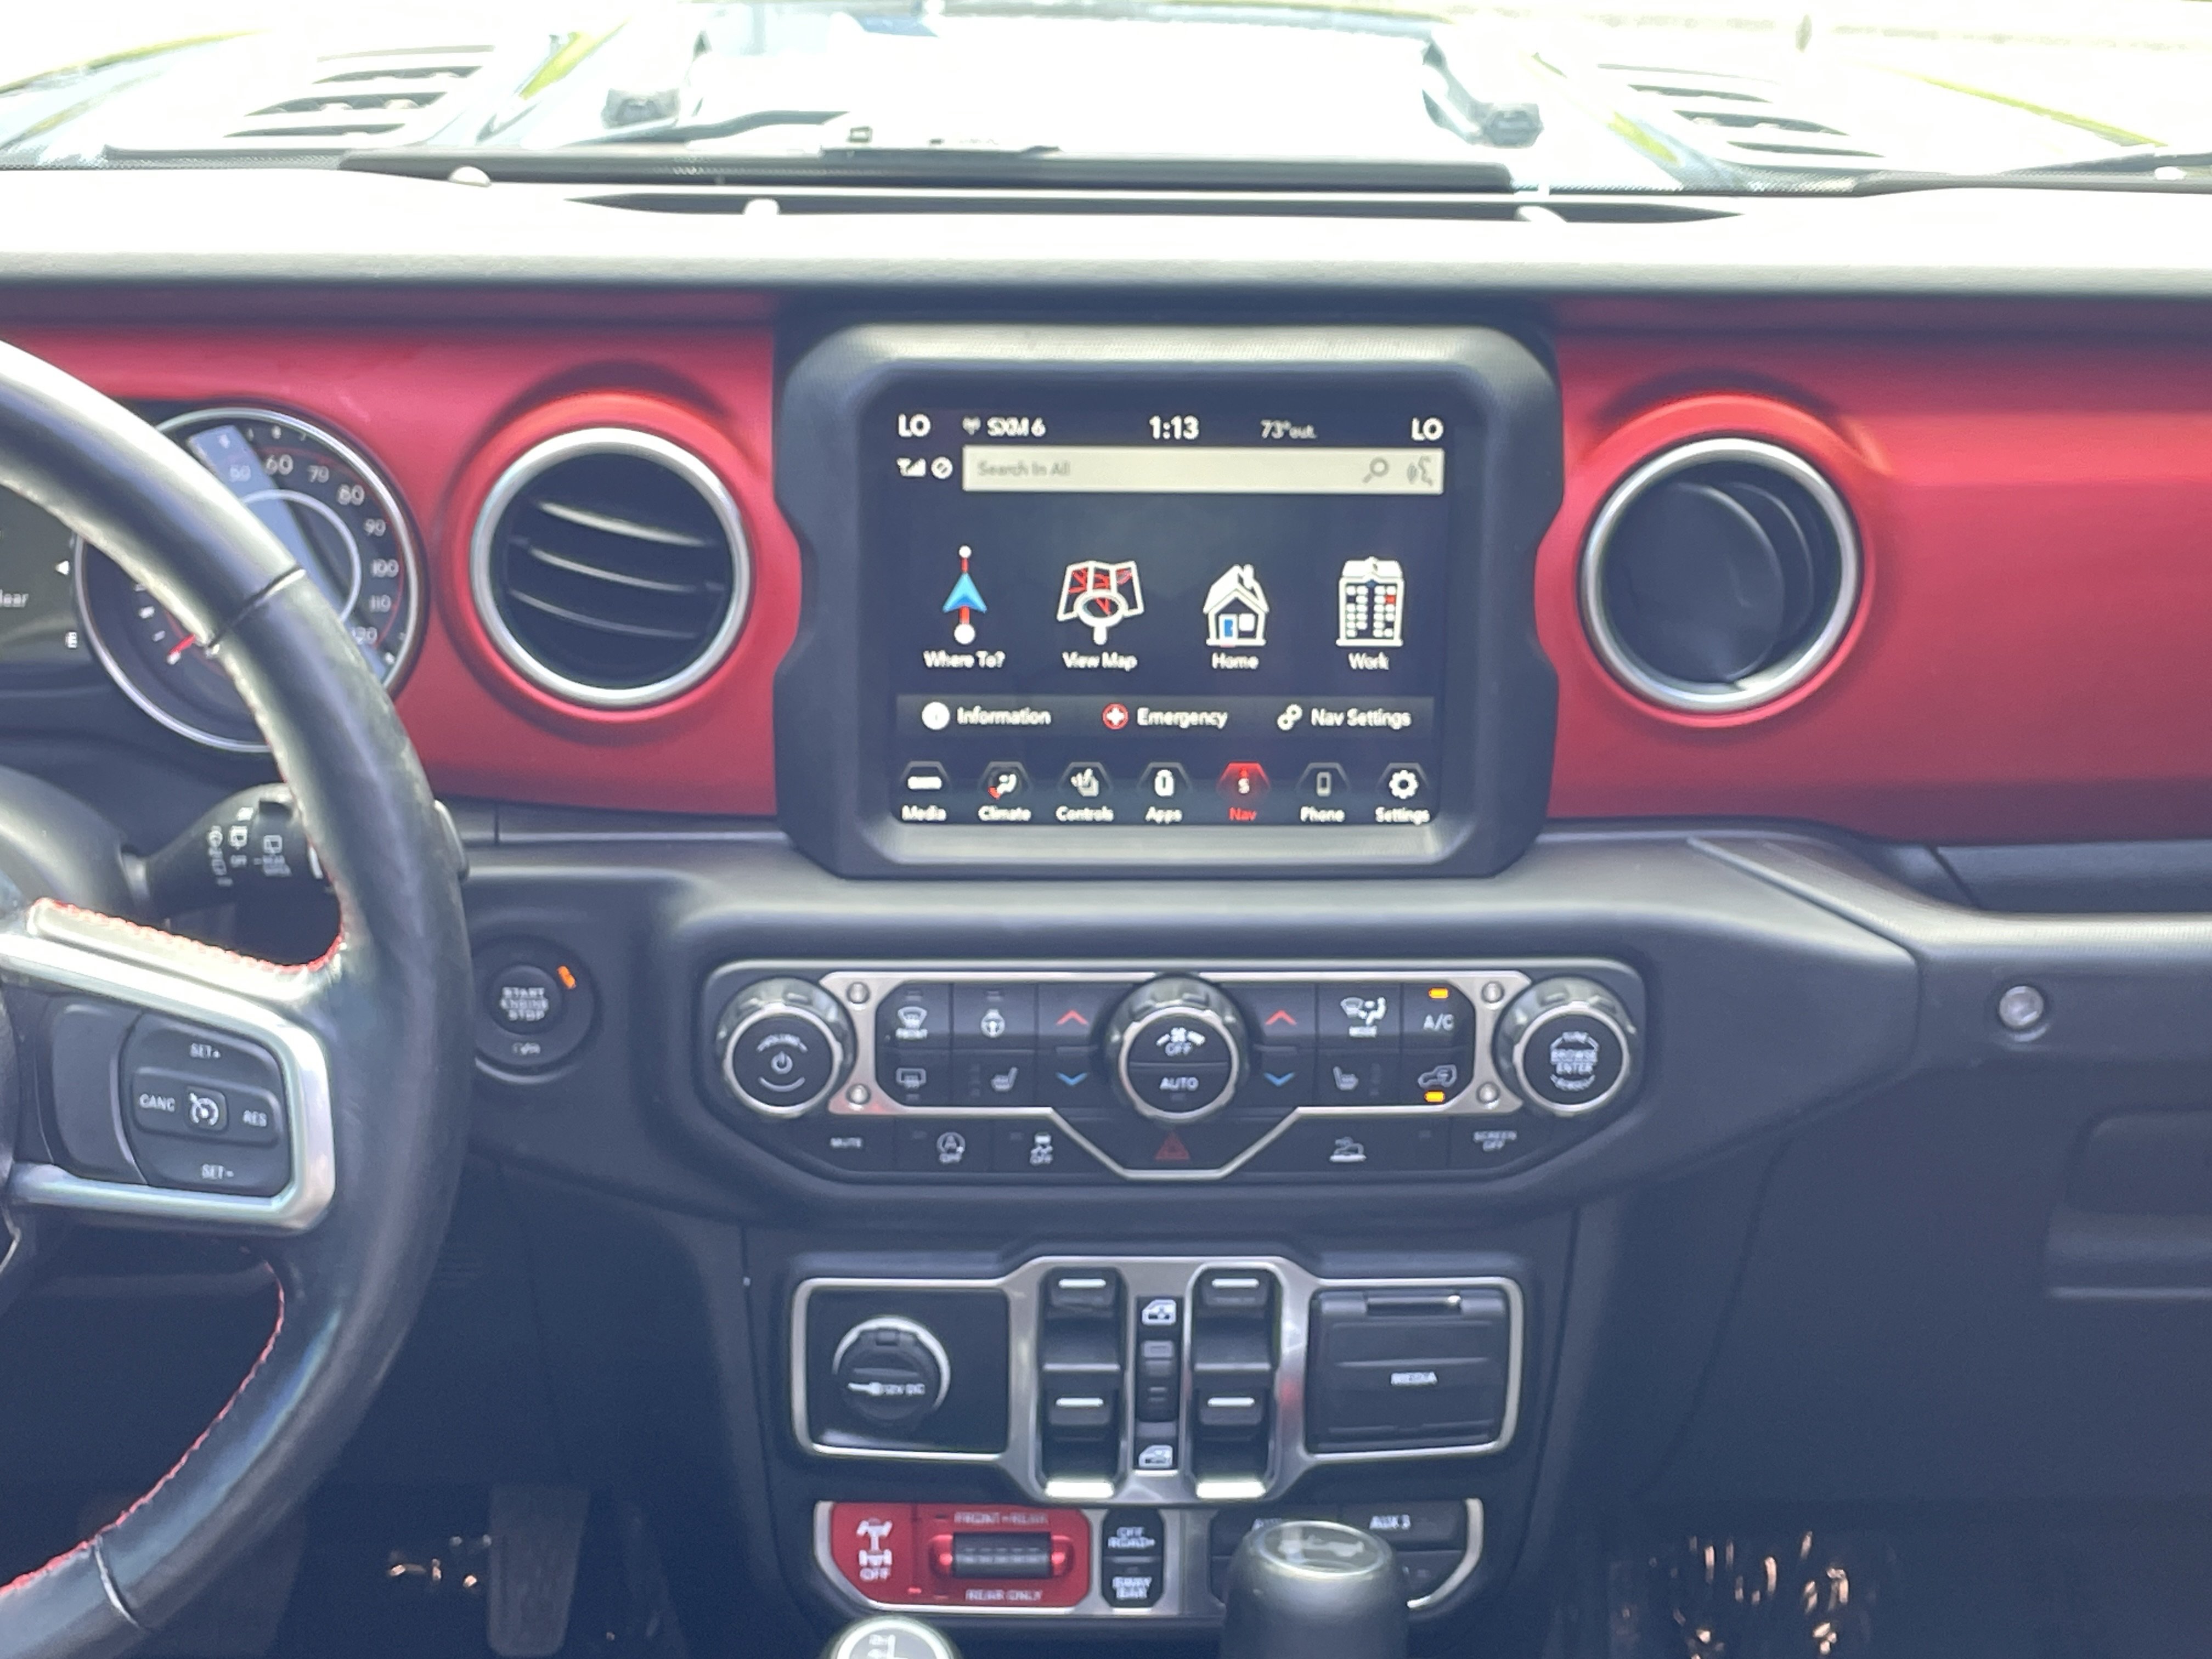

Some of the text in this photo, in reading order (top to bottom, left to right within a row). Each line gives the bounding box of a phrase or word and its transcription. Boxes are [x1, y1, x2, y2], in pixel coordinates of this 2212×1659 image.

[898, 413, 931, 437] LO
[987, 416, 1046, 437] SXM 6
[1149, 415, 1200, 439] 1:13
[1410, 417, 1443, 440] LO
[266, 454, 294, 476] 60
[307, 465, 329, 483] 70
[977, 460, 1030, 477] Search
[1051, 460, 1071, 476] All
[336, 484, 365, 506] 80
[363, 518, 386, 537] 90
[370, 558, 399, 578] 100
[369, 594, 391, 612] 110
[923, 650, 1006, 668] Where To?
[1062, 651, 1138, 672] View Map
[1211, 652, 1260, 669] Home
[1348, 652, 1389, 670] Work
[956, 706, 1051, 726] Information
[1136, 707, 1228, 730] Emergency
[1311, 708, 1412, 730] Nav Settings
[901, 804, 947, 821] Media
[978, 805, 1031, 821] Climate
[1056, 805, 1114, 822] Controls
[1145, 805, 1182, 823] Apps
[1229, 807, 1257, 821] Nav
[1300, 805, 1346, 823] Phone
[1375, 806, 1430, 825] Settings
[502, 987, 545, 998] START
[500, 998, 548, 1010] ENGINE
[509, 1009, 545, 1021] STOP
[1423, 1013, 1454, 1031] A/C
[1165, 1042, 1193, 1057] OFF
[1159, 1077, 1199, 1091] AUTO
[139, 1093, 176, 1112] CANC
[830, 1137, 862, 1148] MUTE
[1391, 1372, 1437, 1385] MEDIA
[860, 1567, 891, 1581] OFF
